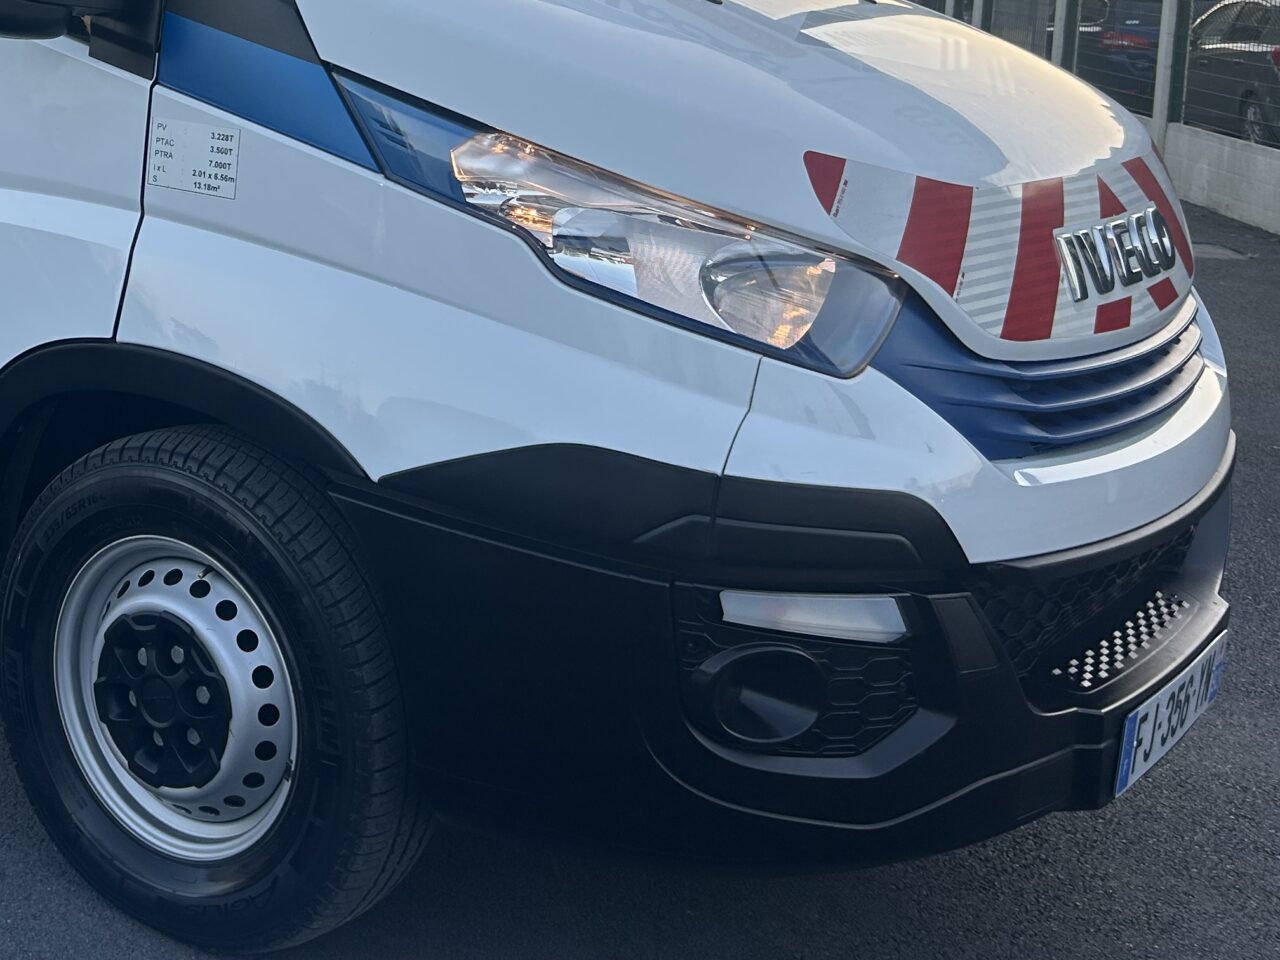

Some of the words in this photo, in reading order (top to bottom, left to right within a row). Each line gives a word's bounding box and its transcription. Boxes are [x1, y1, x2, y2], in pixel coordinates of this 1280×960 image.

[157, 122, 167, 131] PV
[155, 136, 175, 147] PTAC
[154, 149, 174, 160] PTRA
[1056, 207, 1176, 303] IVECO
